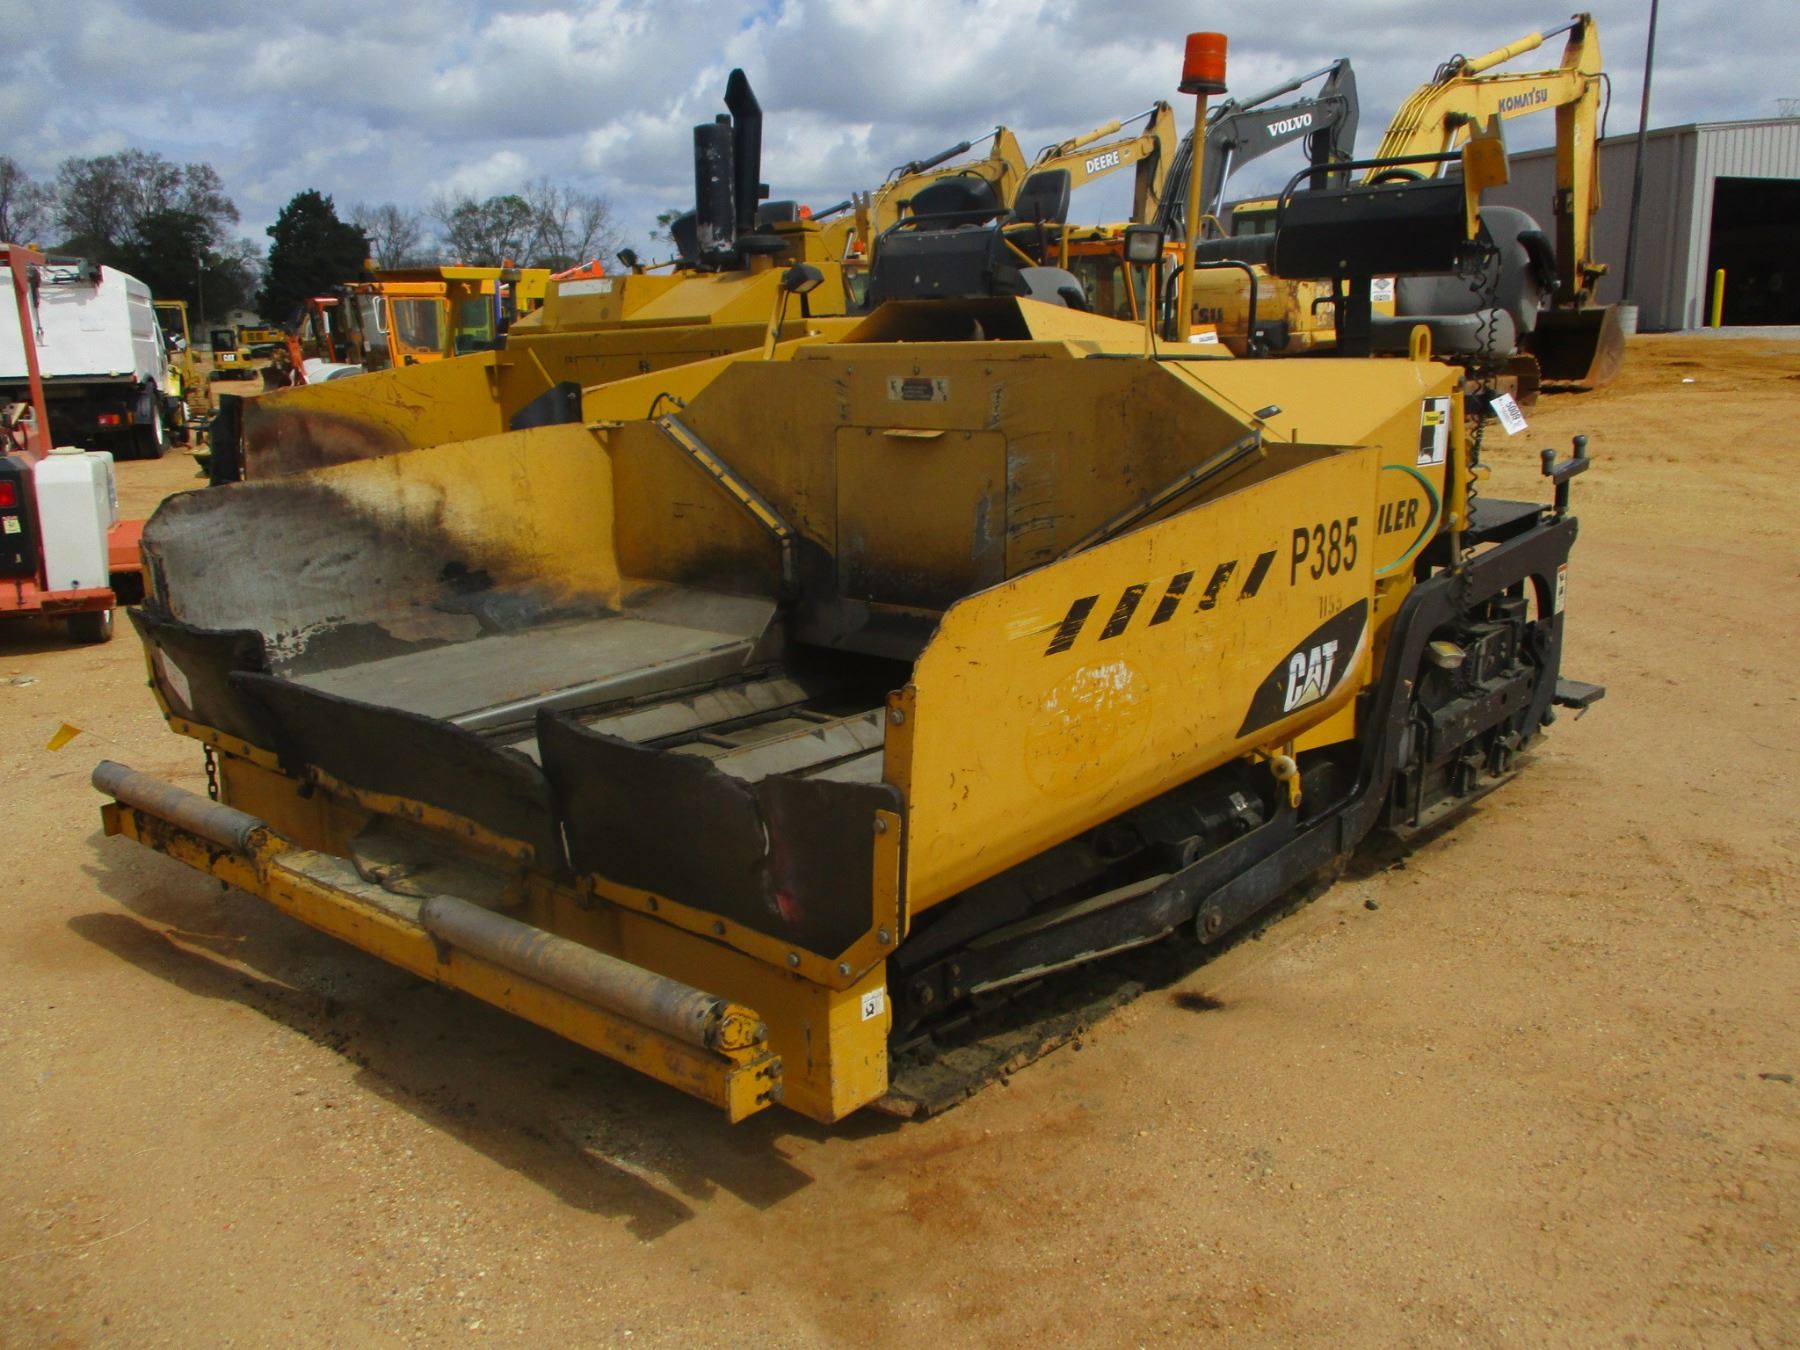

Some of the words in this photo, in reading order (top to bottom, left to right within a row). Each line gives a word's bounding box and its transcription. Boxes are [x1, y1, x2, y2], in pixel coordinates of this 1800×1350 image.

[1267, 113, 1313, 137] VOLVO
[1086, 151, 1120, 174] DEERE
[1377, 498, 1418, 536] ILER
[1290, 516, 1358, 587] P385
[1284, 639, 1338, 712] CAT
